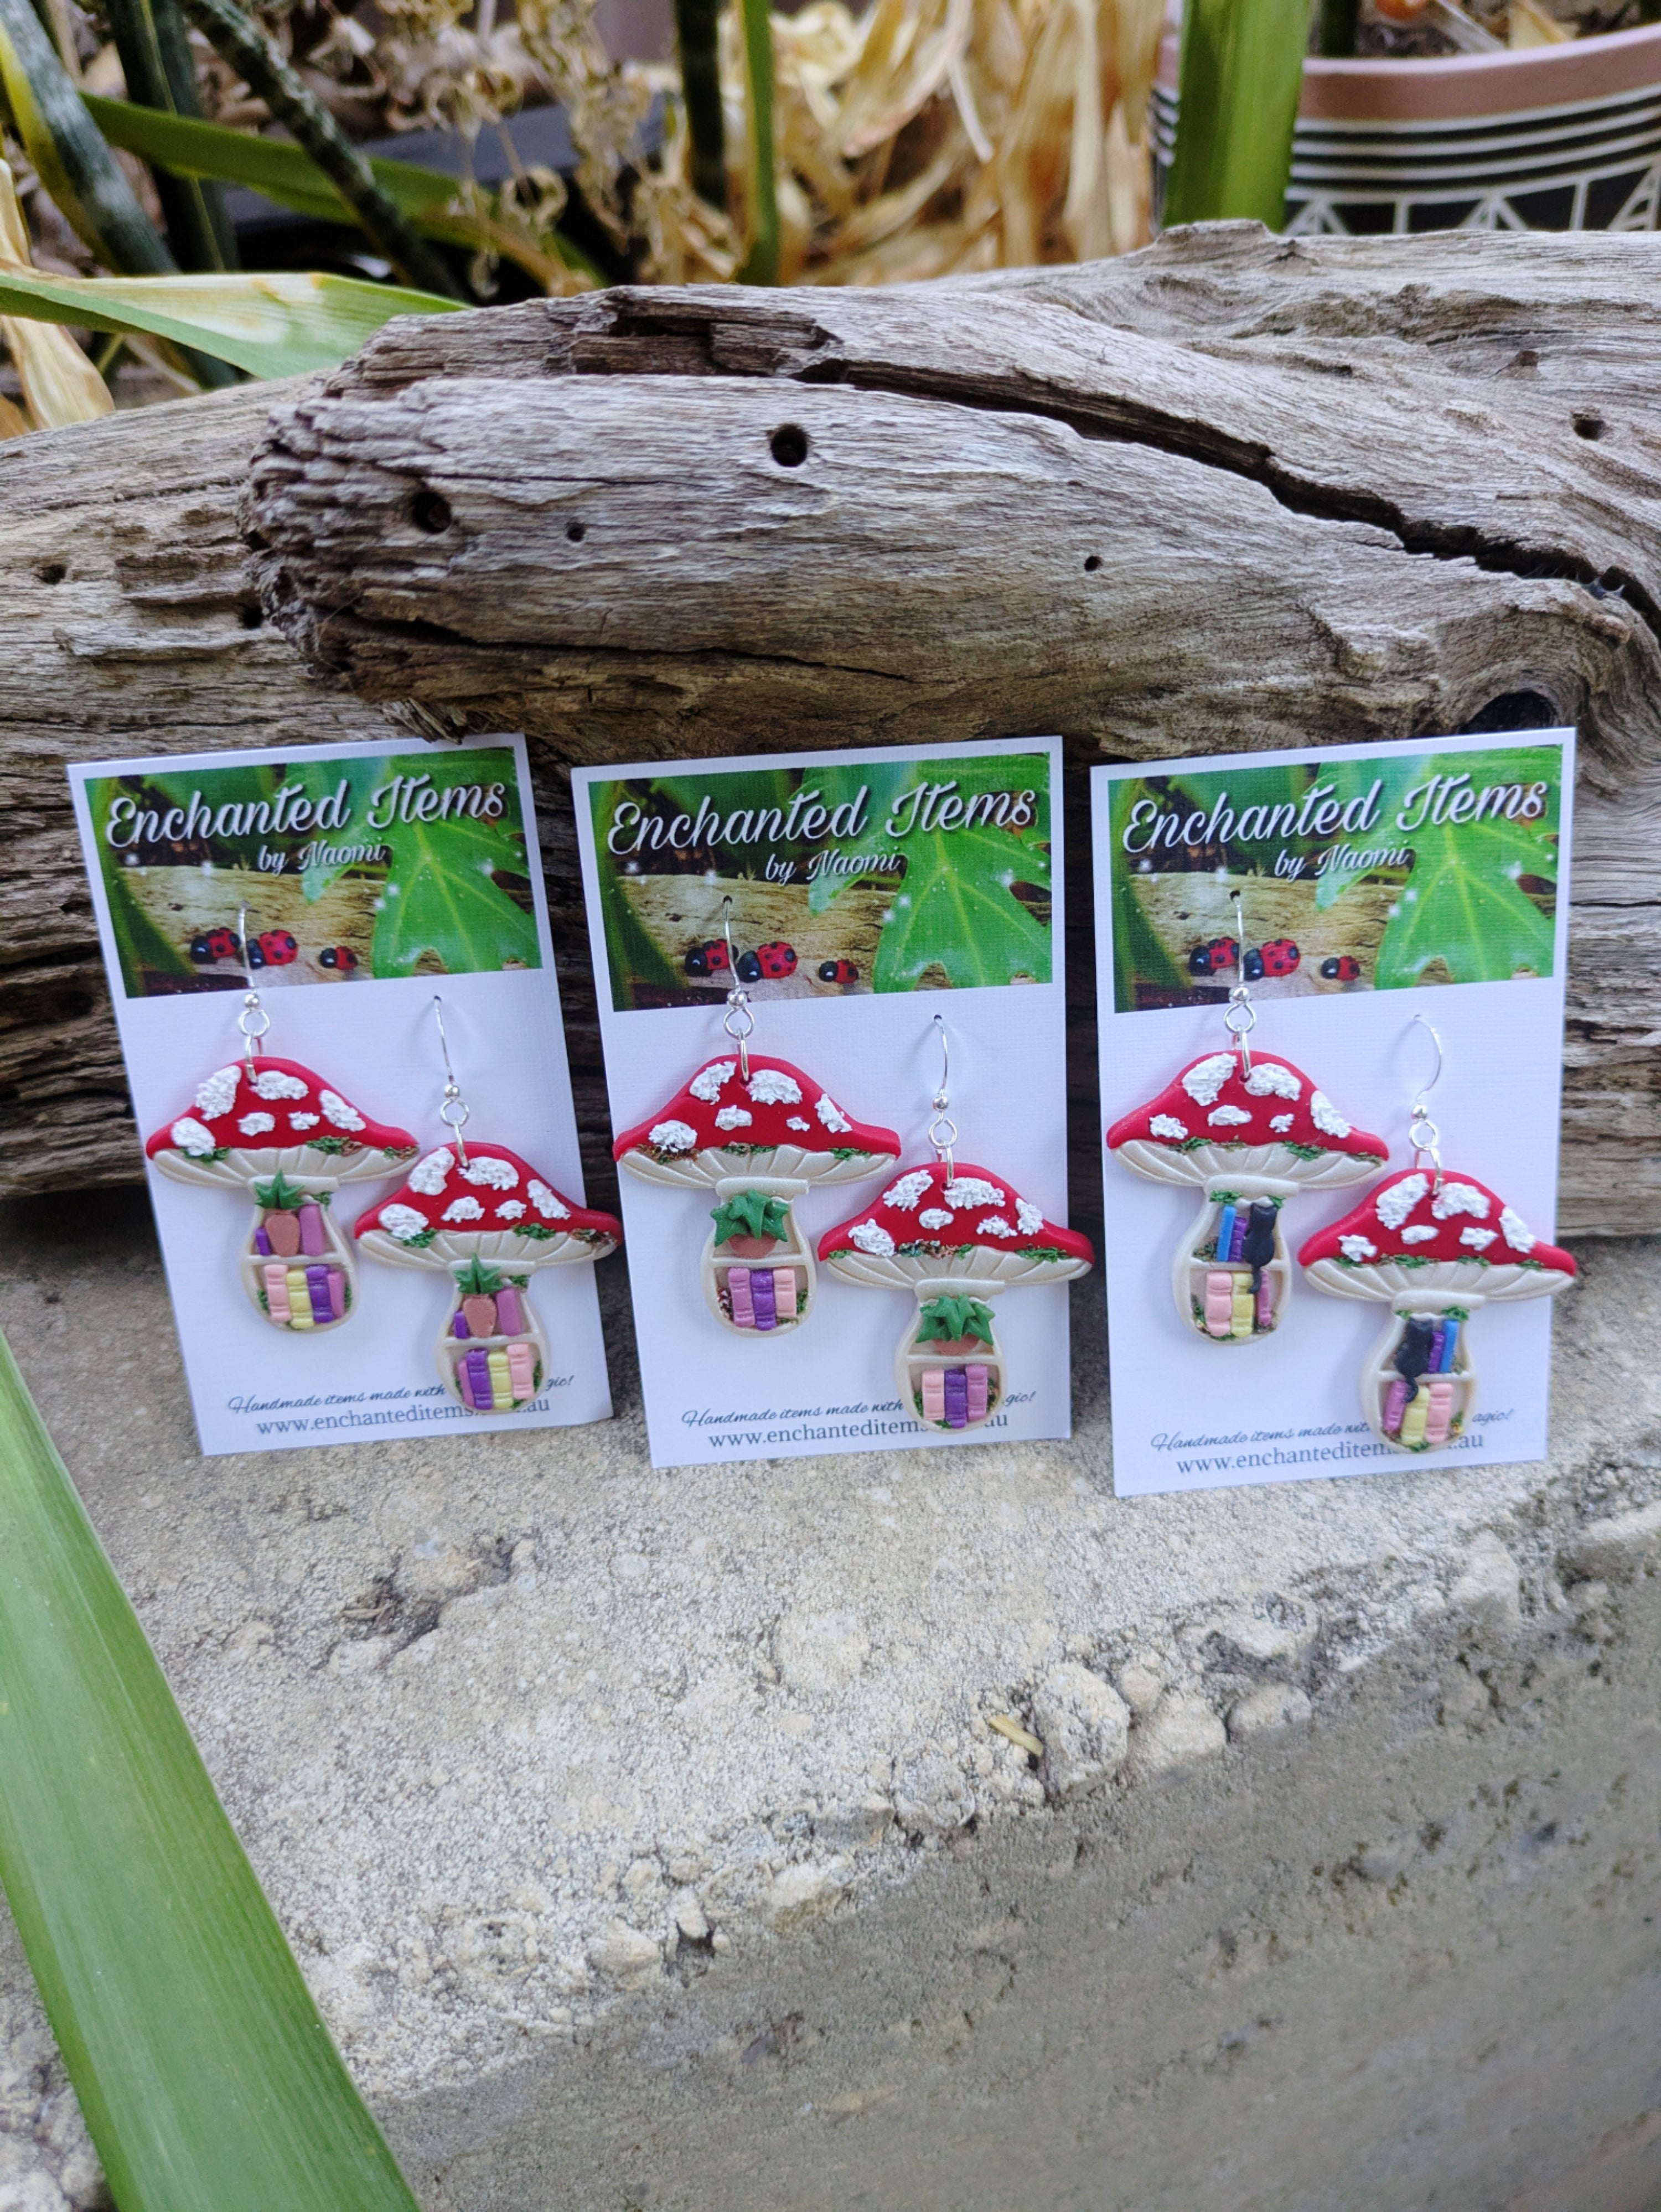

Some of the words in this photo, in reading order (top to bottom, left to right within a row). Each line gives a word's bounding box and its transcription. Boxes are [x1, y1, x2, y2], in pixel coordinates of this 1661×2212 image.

[106, 779, 350, 847] Enchanted
[368, 774, 505, 829] Items
[607, 785, 868, 855] Enchanted
[887, 780, 1036, 837] Items
[1122, 779, 1382, 853] Enchanted
[1396, 774, 1548, 832] Items
[258, 846, 288, 875] by
[297, 837, 386, 869] Naomi
[765, 853, 795, 885] by
[806, 846, 901, 880] Naomi
[1274, 849, 1305, 882] by
[1316, 840, 1411, 875] Naomi
[228, 1395, 322, 1414] Handmade
[324, 1392, 367, 1406] items
[369, 1387, 412, 1401] made
[415, 1385, 447, 1398] with
[681, 1409, 778, 1428] Handmade
[779, 1405, 822, 1420] items
[825, 1401, 870, 1415] made
[872, 1398, 904, 1412] with
[1151, 1432, 1248, 1453] Handmade
[1250, 1427, 1295, 1443] items
[1298, 1423, 1342, 1437] made
[1344, 1421, 1370, 1434] wit
